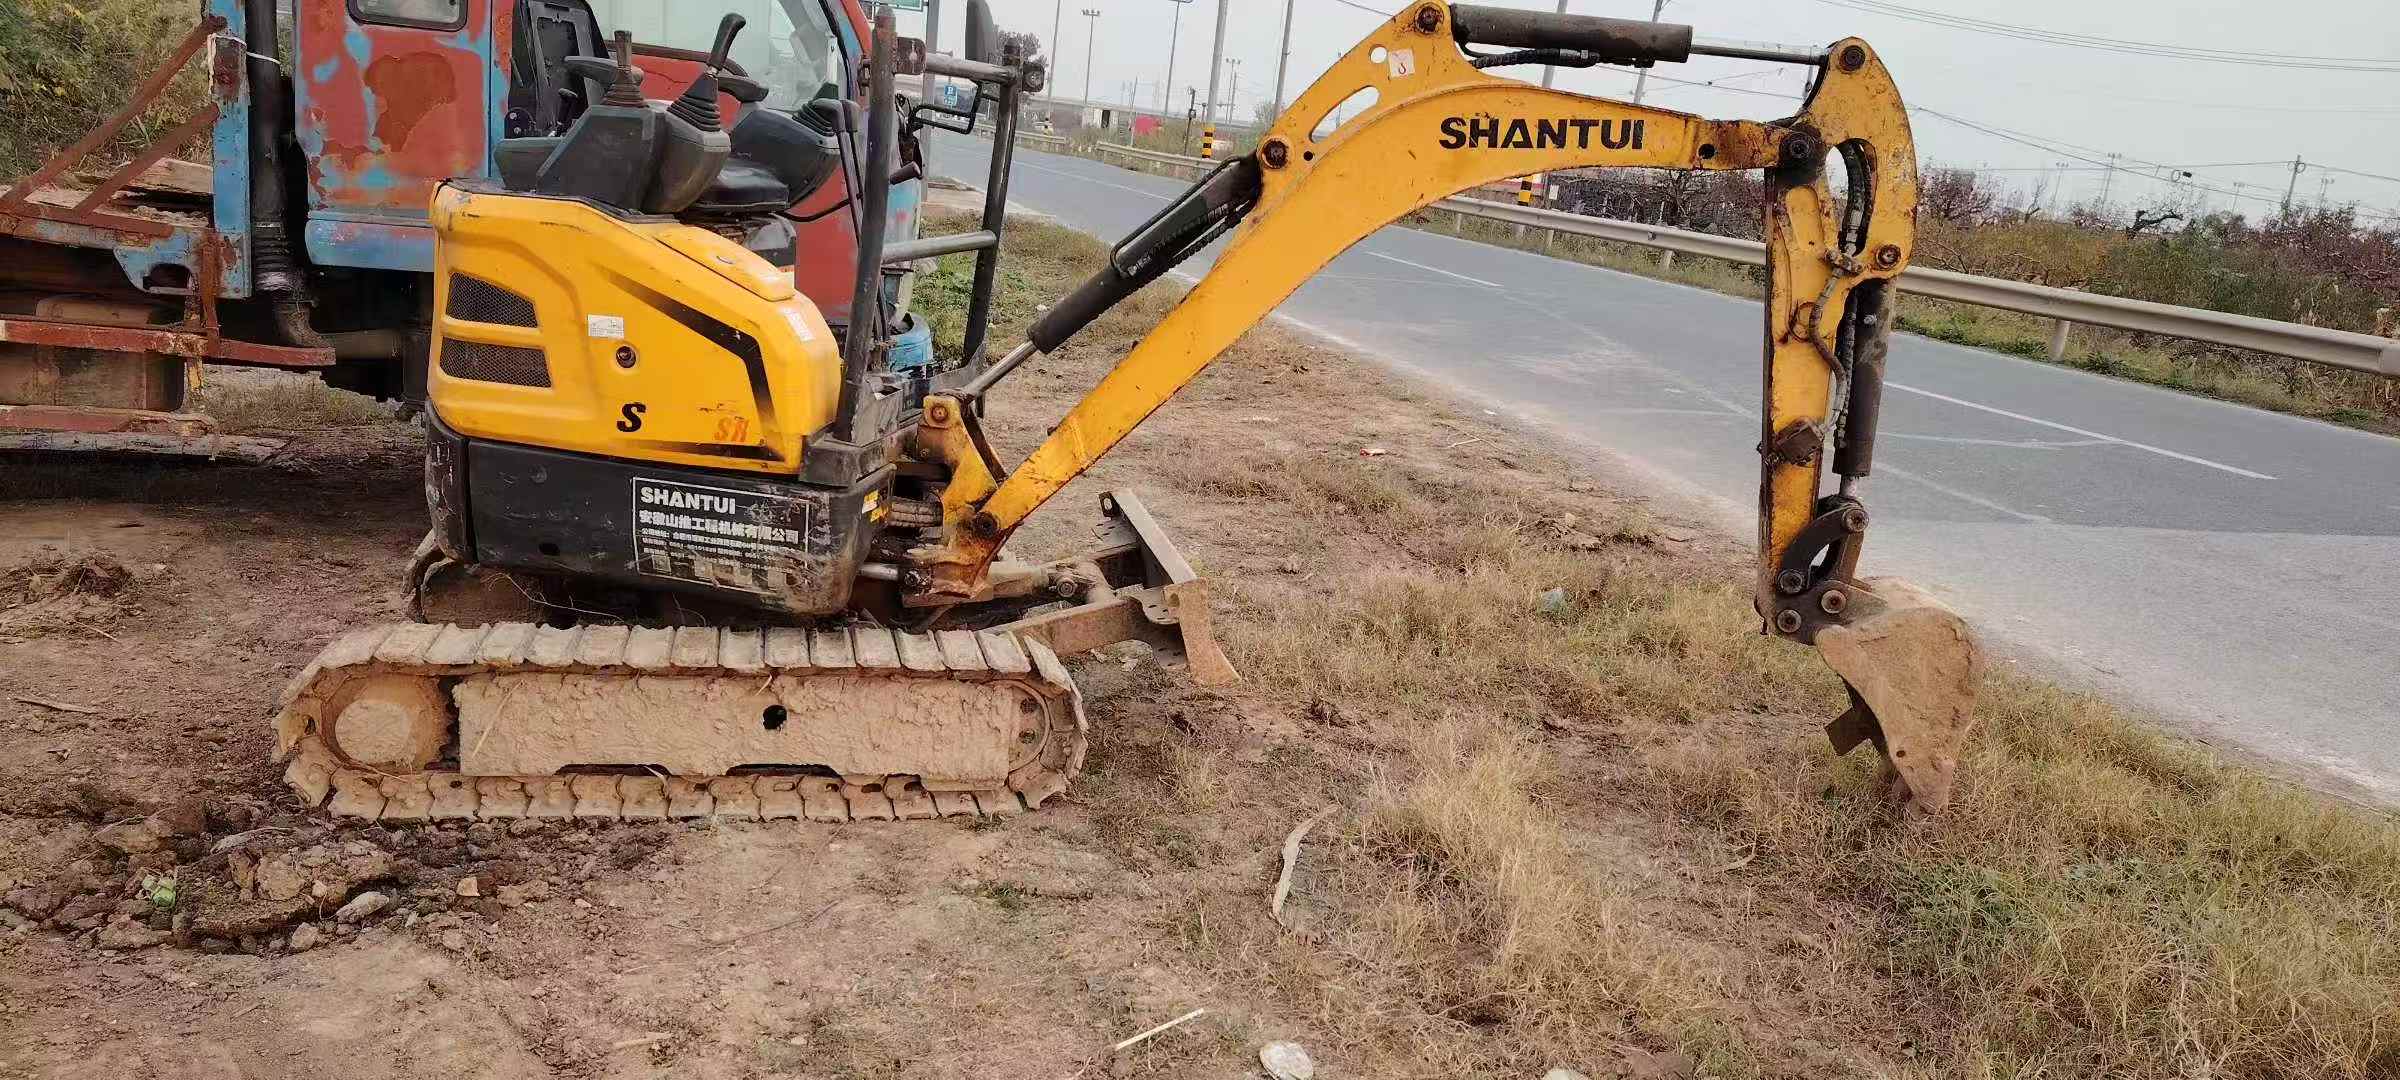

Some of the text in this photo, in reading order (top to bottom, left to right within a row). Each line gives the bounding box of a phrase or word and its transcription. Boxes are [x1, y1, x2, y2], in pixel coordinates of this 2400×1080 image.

[1439, 117, 1644, 149] SHANTUI
[617, 402, 646, 432] S
[640, 486, 736, 514] SHANTUI
